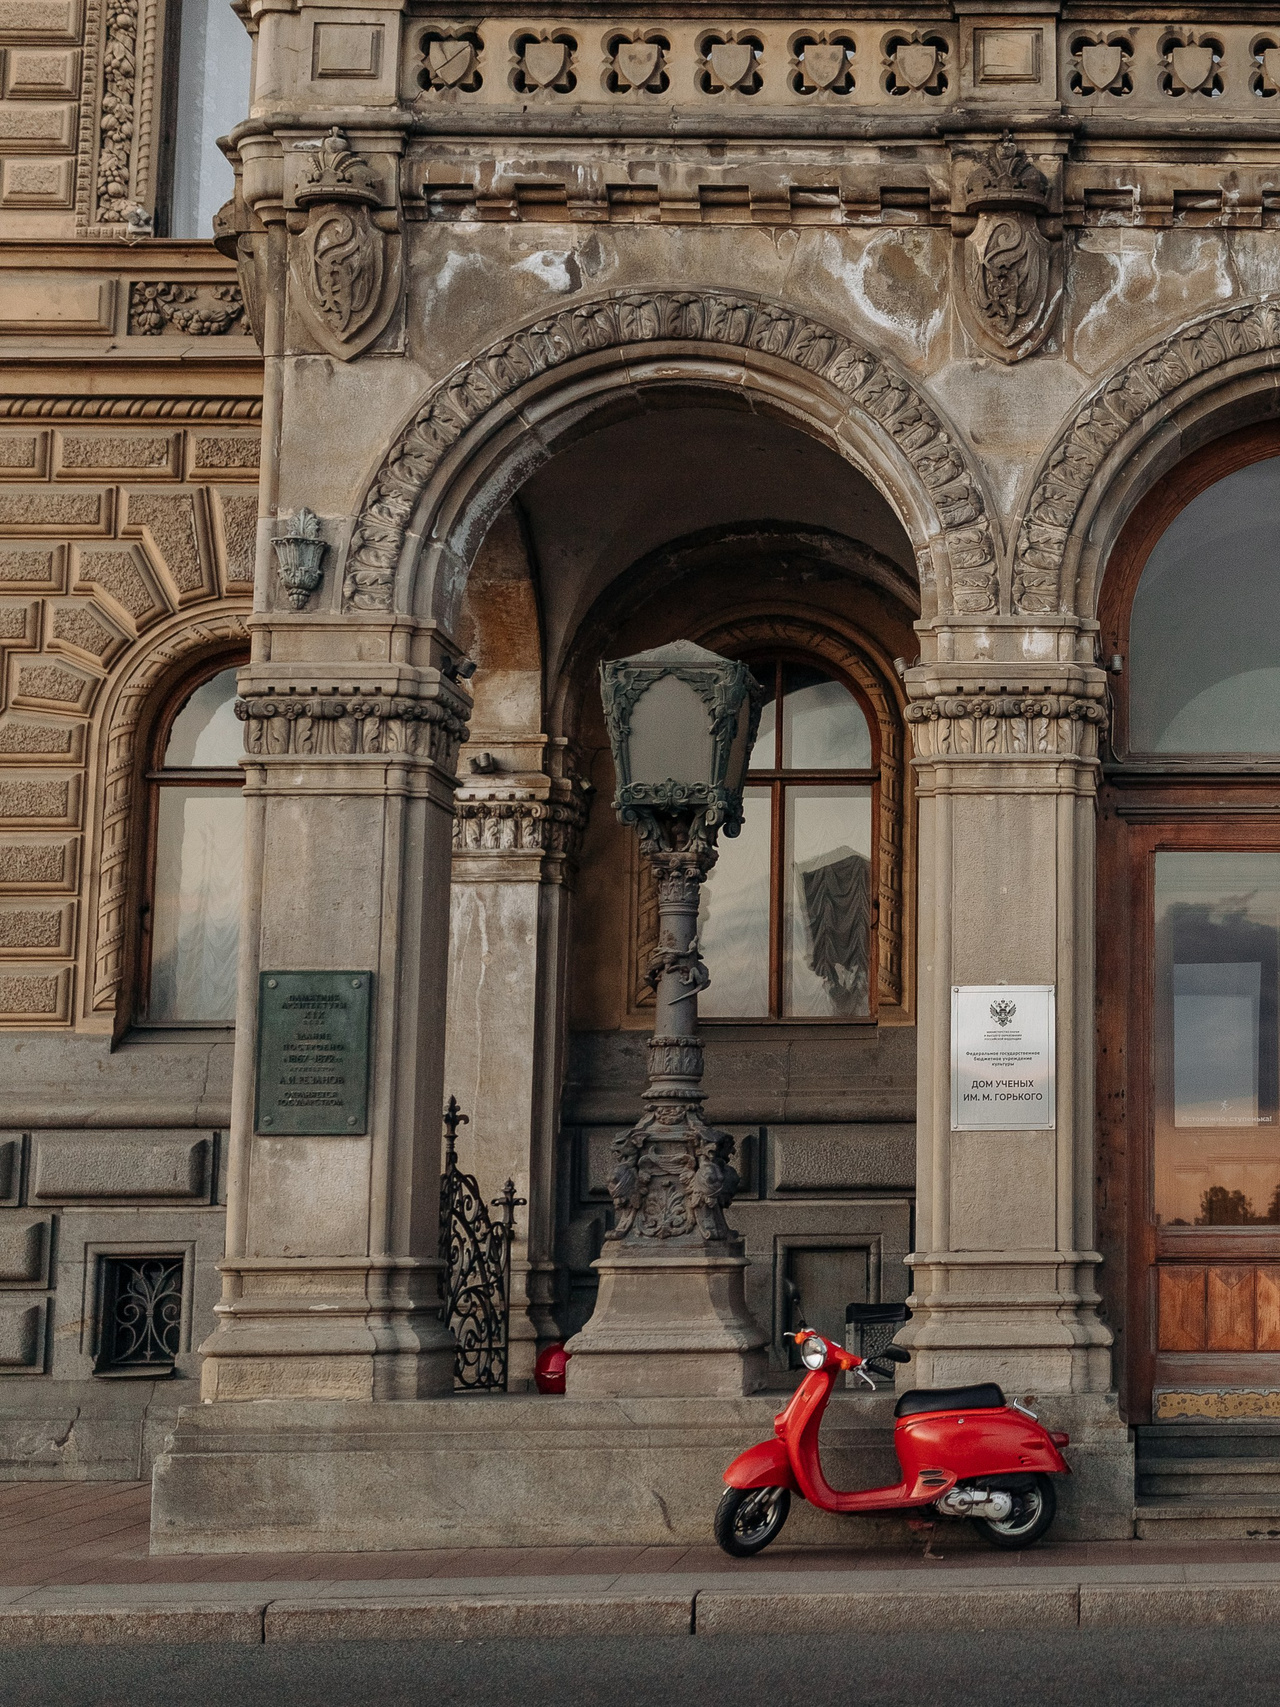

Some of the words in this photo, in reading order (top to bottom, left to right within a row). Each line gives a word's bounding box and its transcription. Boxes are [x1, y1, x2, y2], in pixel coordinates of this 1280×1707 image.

[971, 1080, 993, 1089] ДОМ
[995, 1079, 1034, 1088] УЧЕНЫХ
[963, 1093, 980, 1101] ИМ.
[982, 1093, 993, 1101] М.
[994, 1092, 1043, 1101] ГОРЬКОГО
[1229, 1115, 1273, 1123] ступенька!
